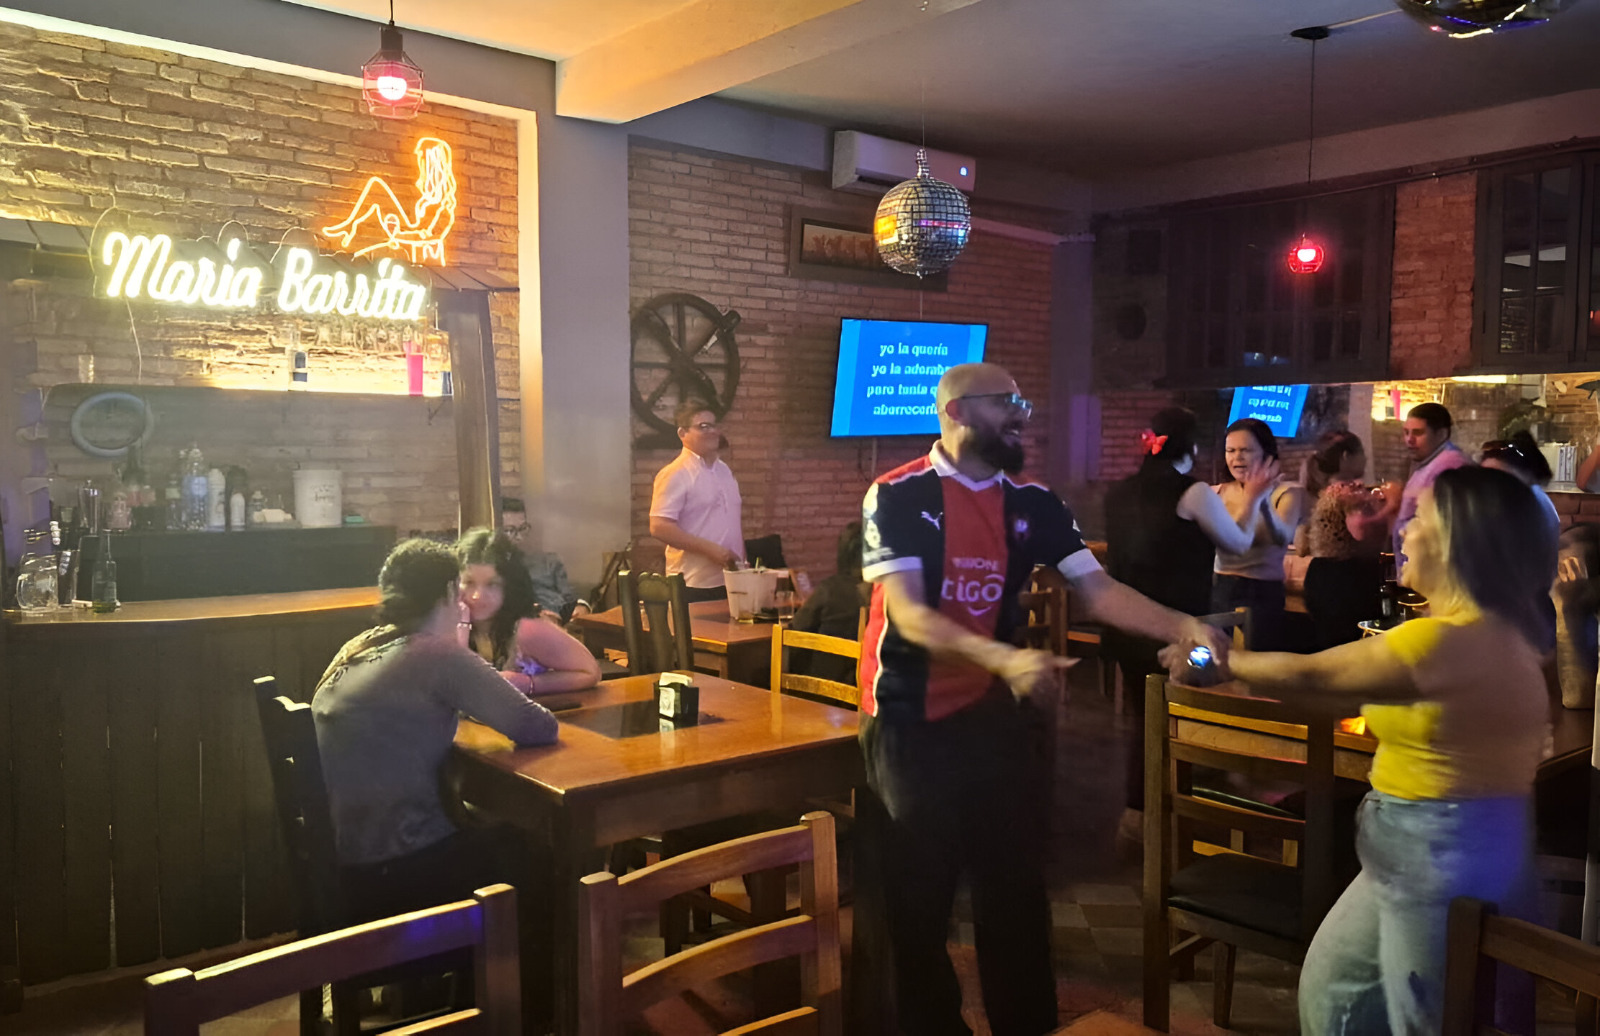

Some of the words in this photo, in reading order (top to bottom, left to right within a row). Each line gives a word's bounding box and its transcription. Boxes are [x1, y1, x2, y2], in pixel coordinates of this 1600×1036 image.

[277, 246, 427, 320] Barrita
[880, 344, 894, 357] yo
[898, 342, 909, 354] la
[871, 364, 887, 377] yo
[890, 363, 901, 375] la
